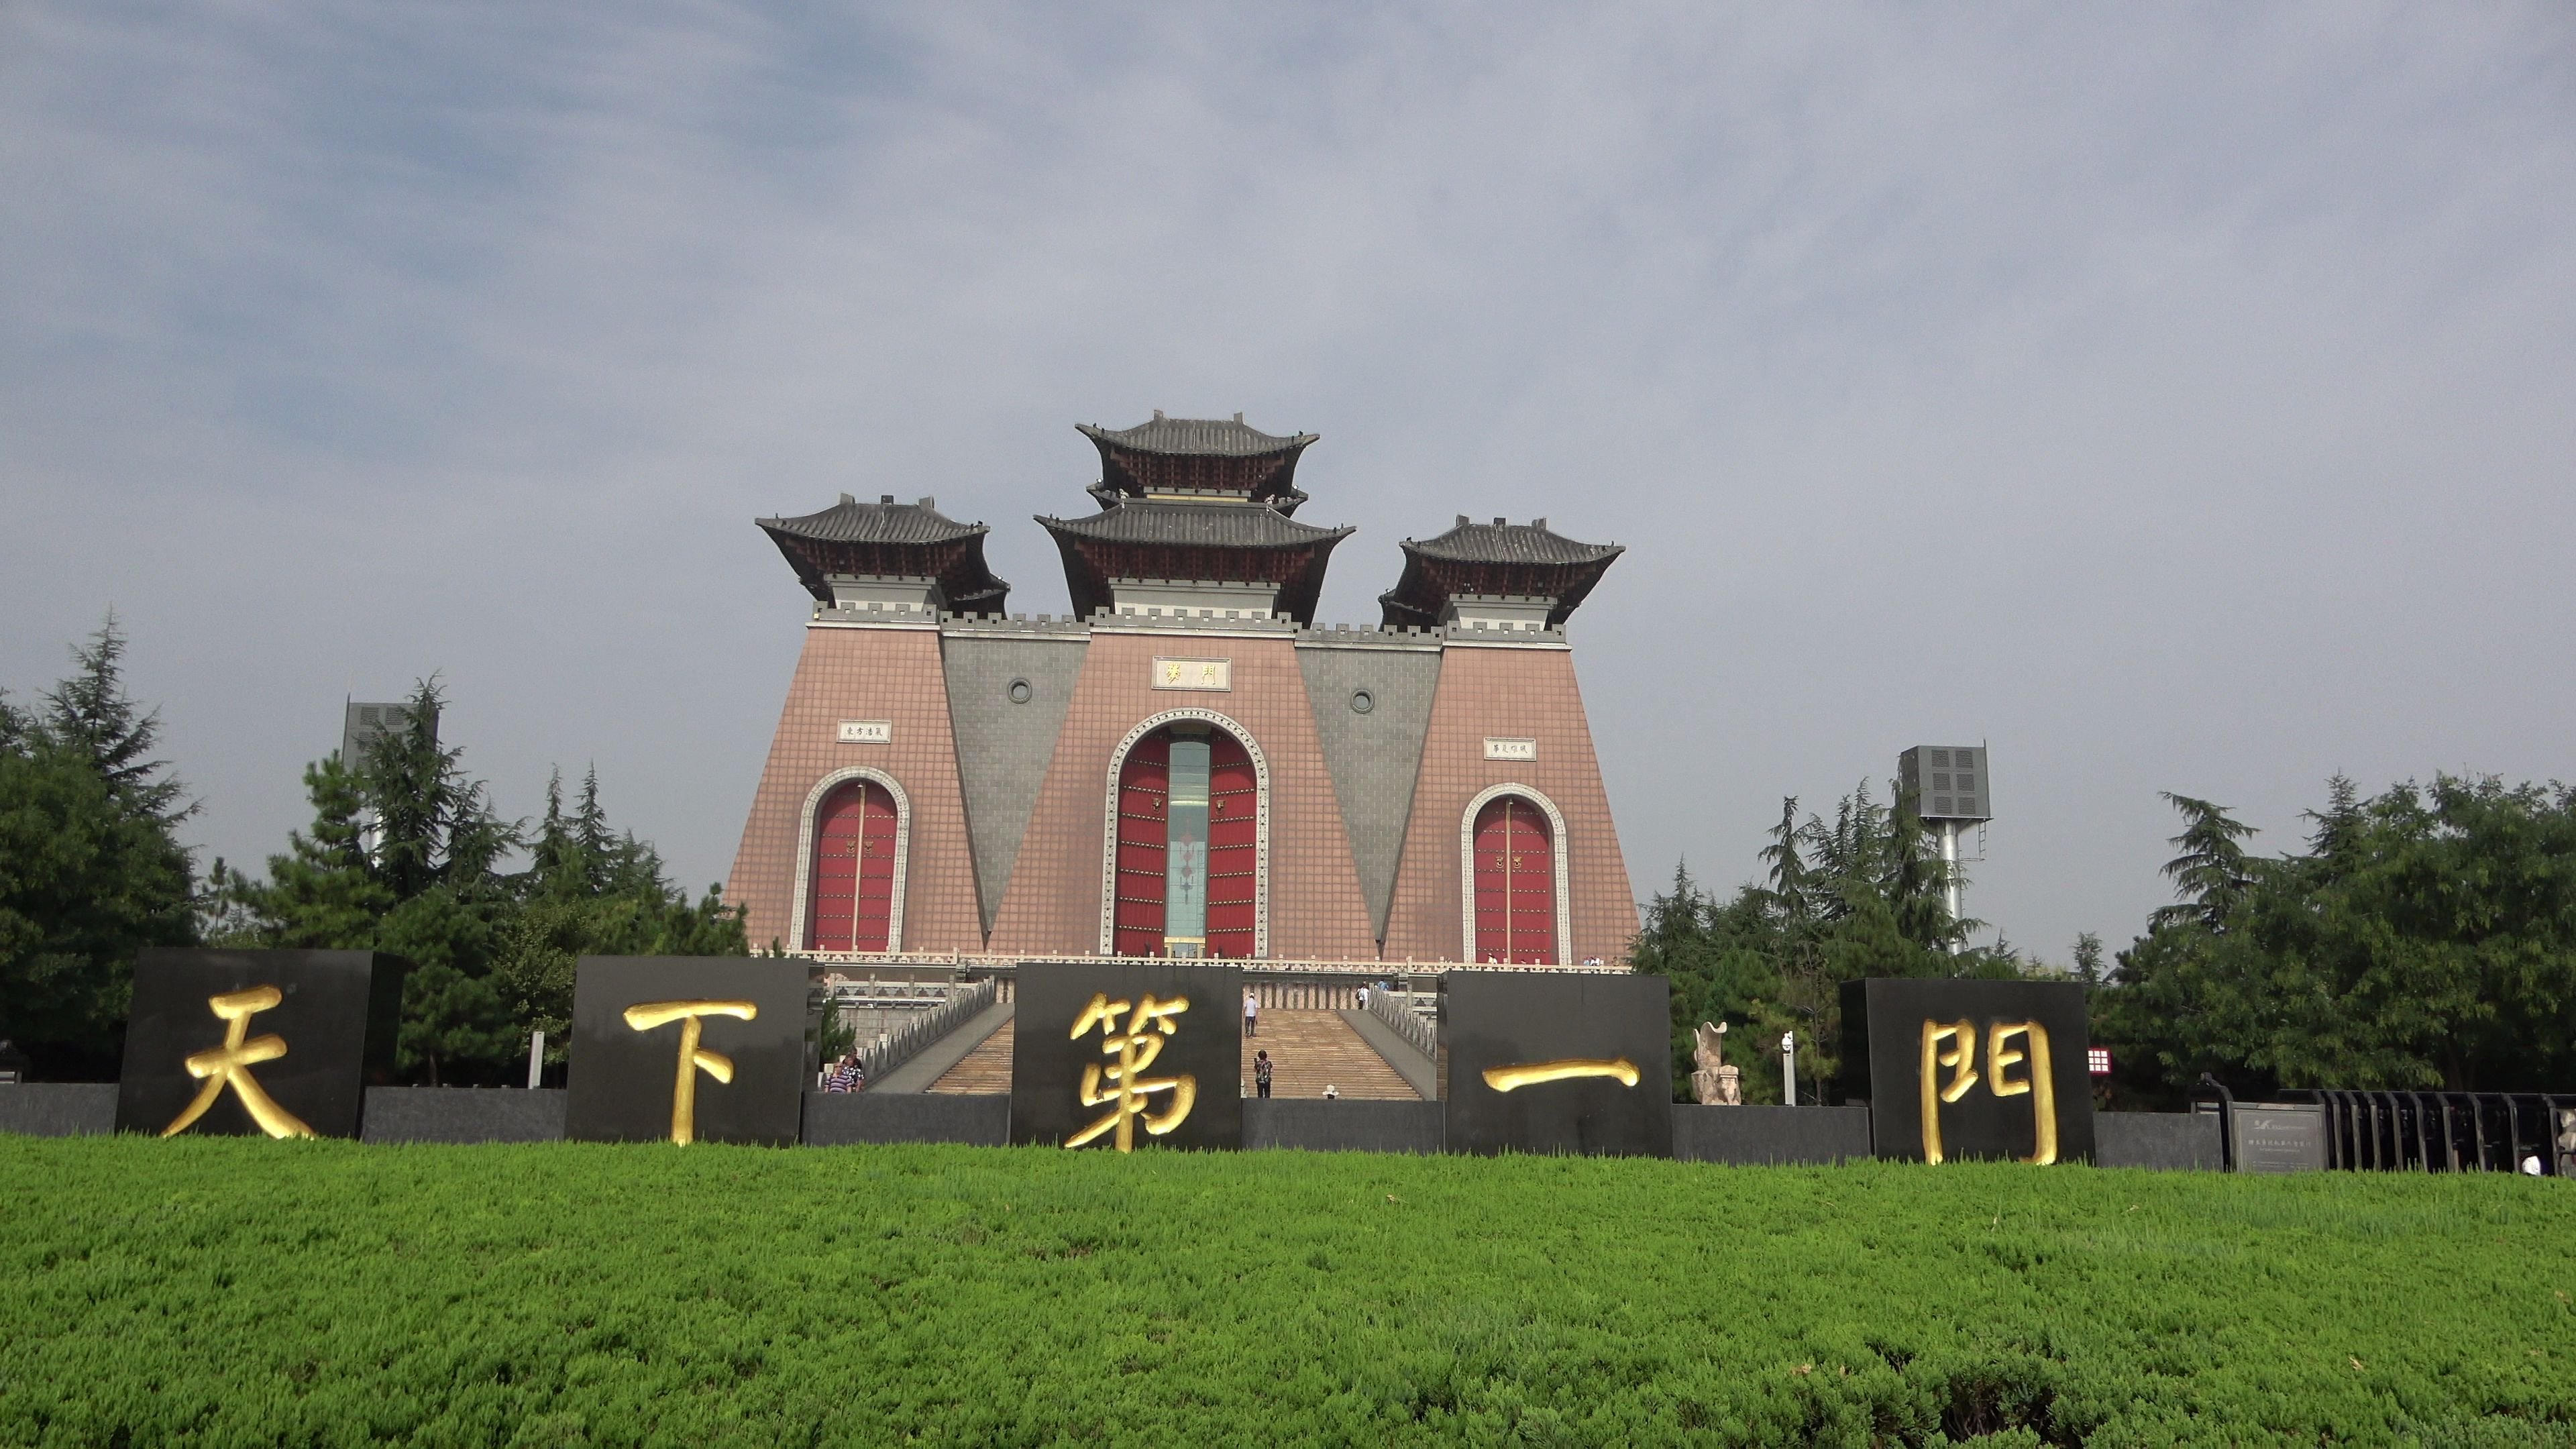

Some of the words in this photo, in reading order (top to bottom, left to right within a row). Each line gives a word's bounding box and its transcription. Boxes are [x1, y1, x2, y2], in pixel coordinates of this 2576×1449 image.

[160, 983, 318, 1140] 天
[623, 999, 758, 1146] 下
[1064, 991, 1197, 1154] 第
[1481, 1055, 1641, 1093] 一
[1920, 1017, 2058, 1167] 門
